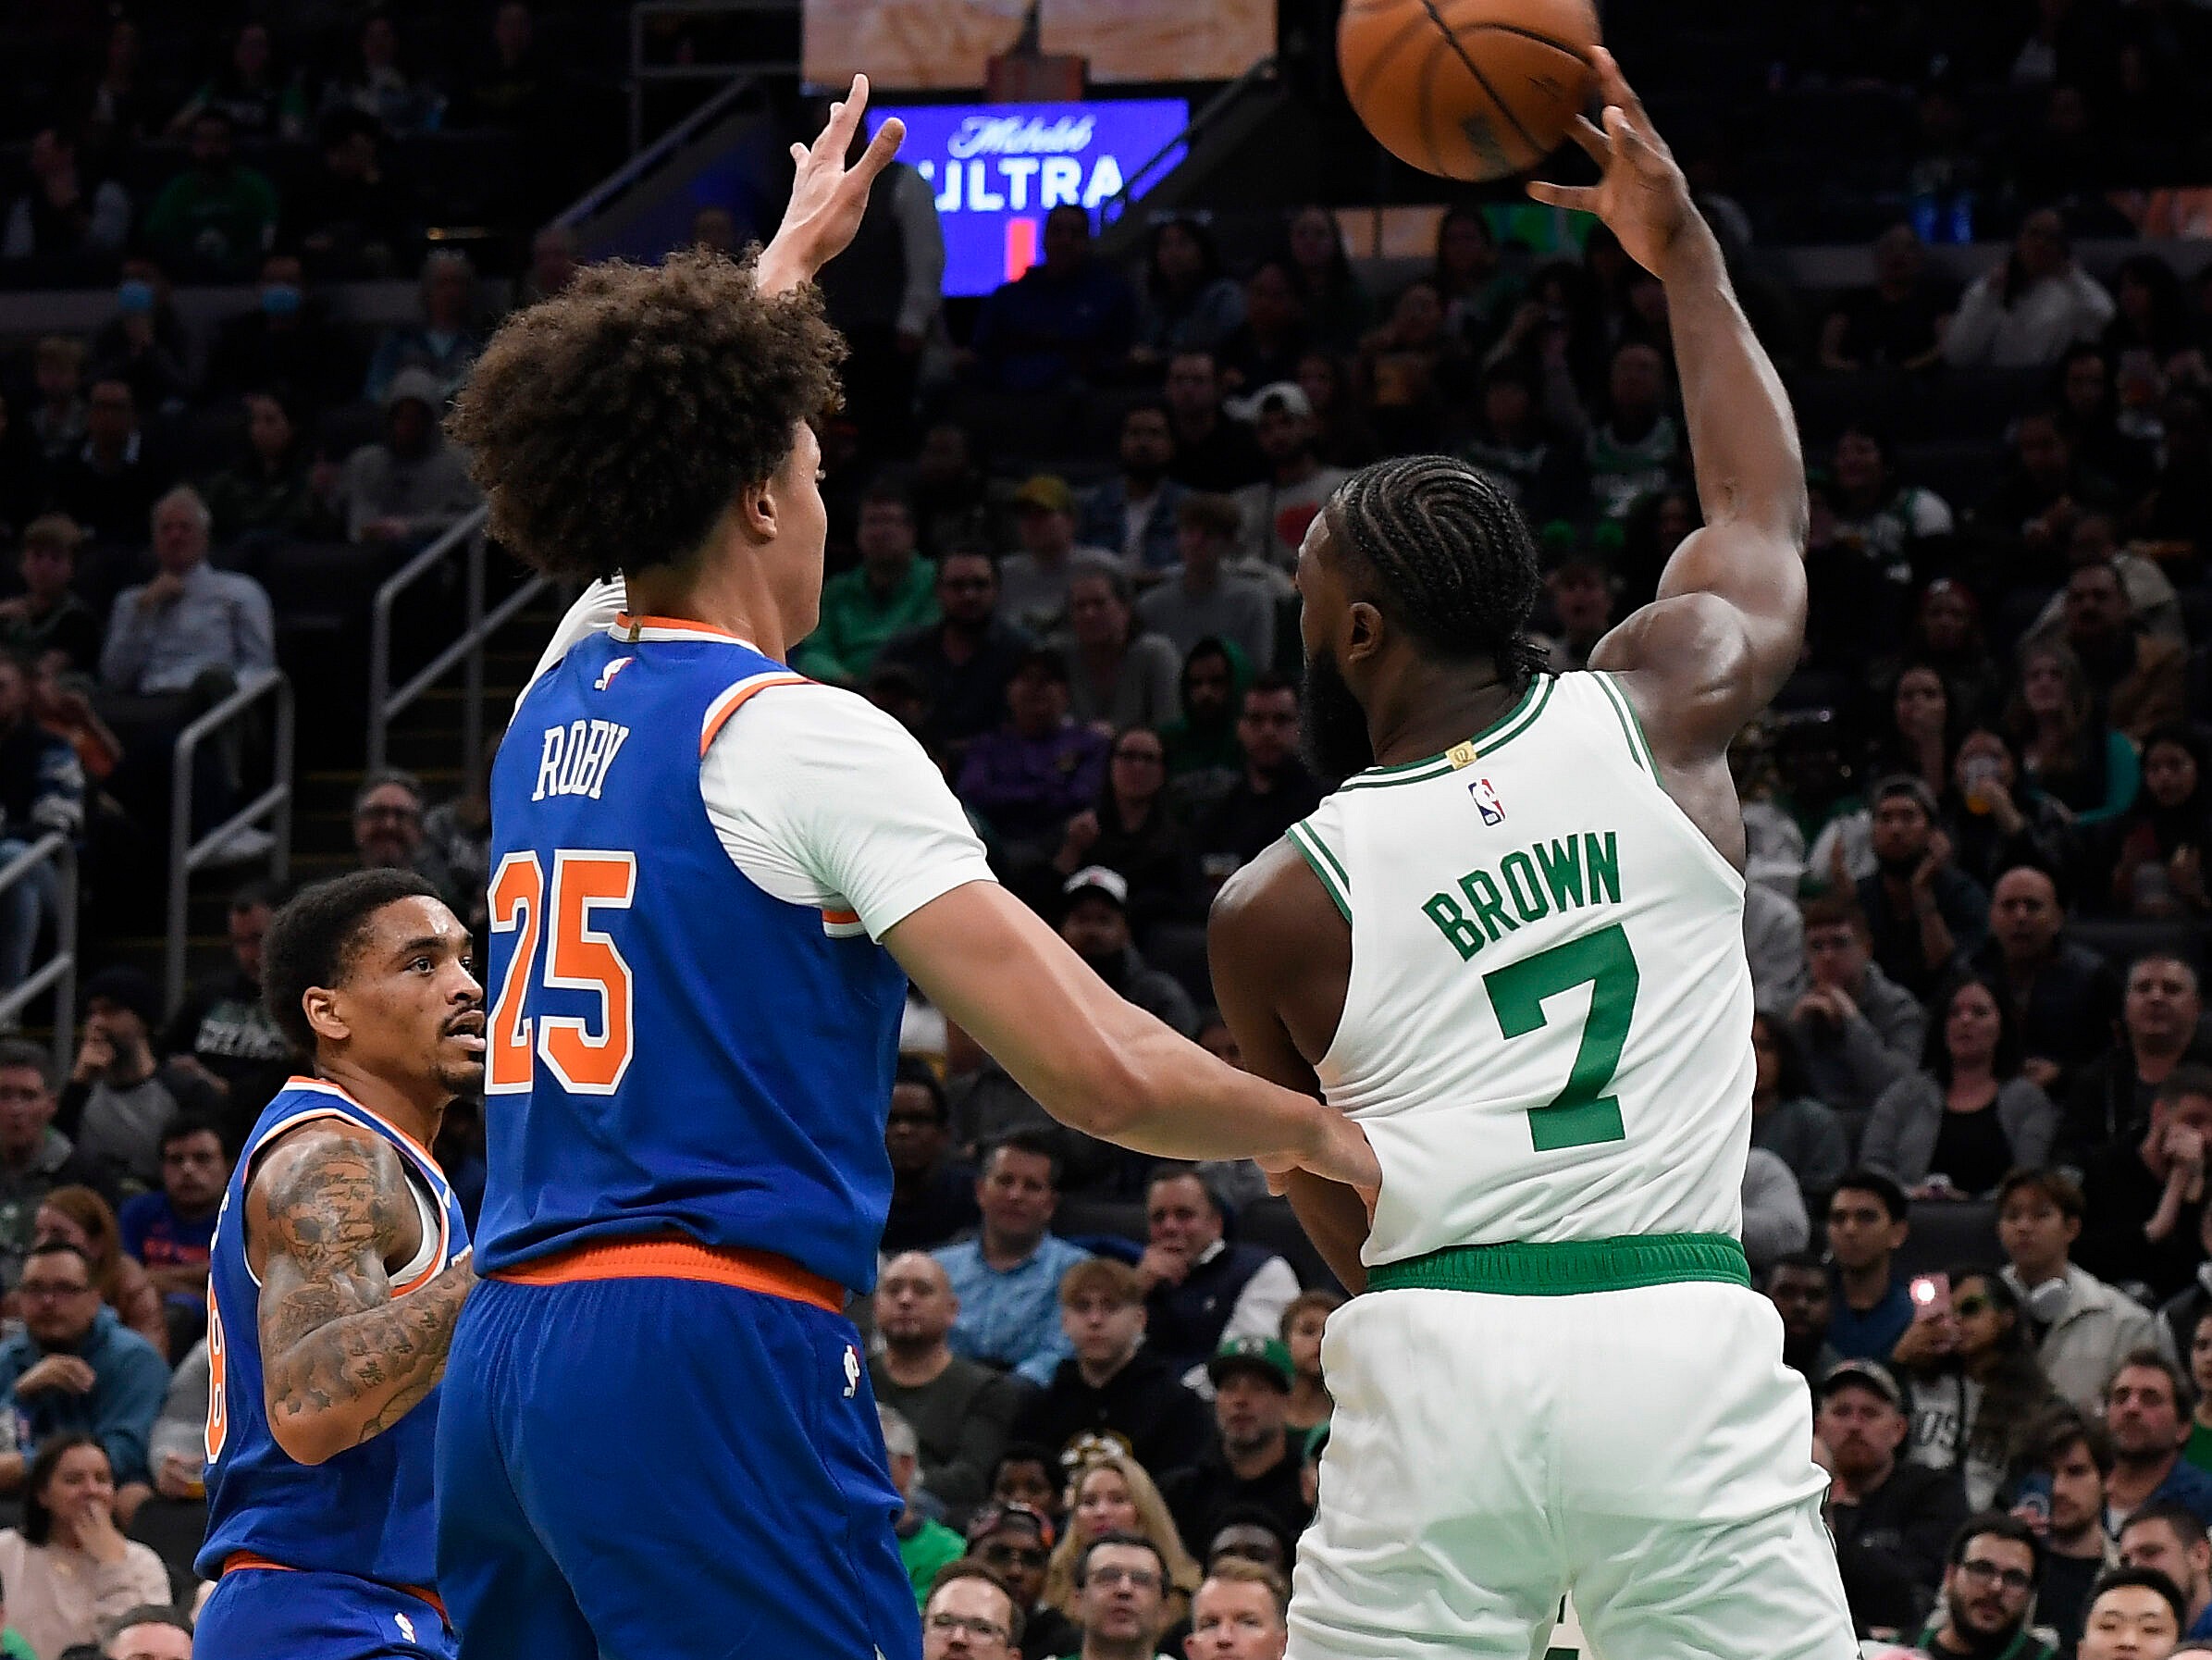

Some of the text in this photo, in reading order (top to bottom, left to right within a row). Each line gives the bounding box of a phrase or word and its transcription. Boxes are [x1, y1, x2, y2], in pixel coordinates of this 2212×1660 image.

[532, 719, 630, 801] ROBY
[484, 849, 636, 1096] 25
[1421, 831, 1621, 961] BROWN
[1482, 922, 1639, 1151] 7
